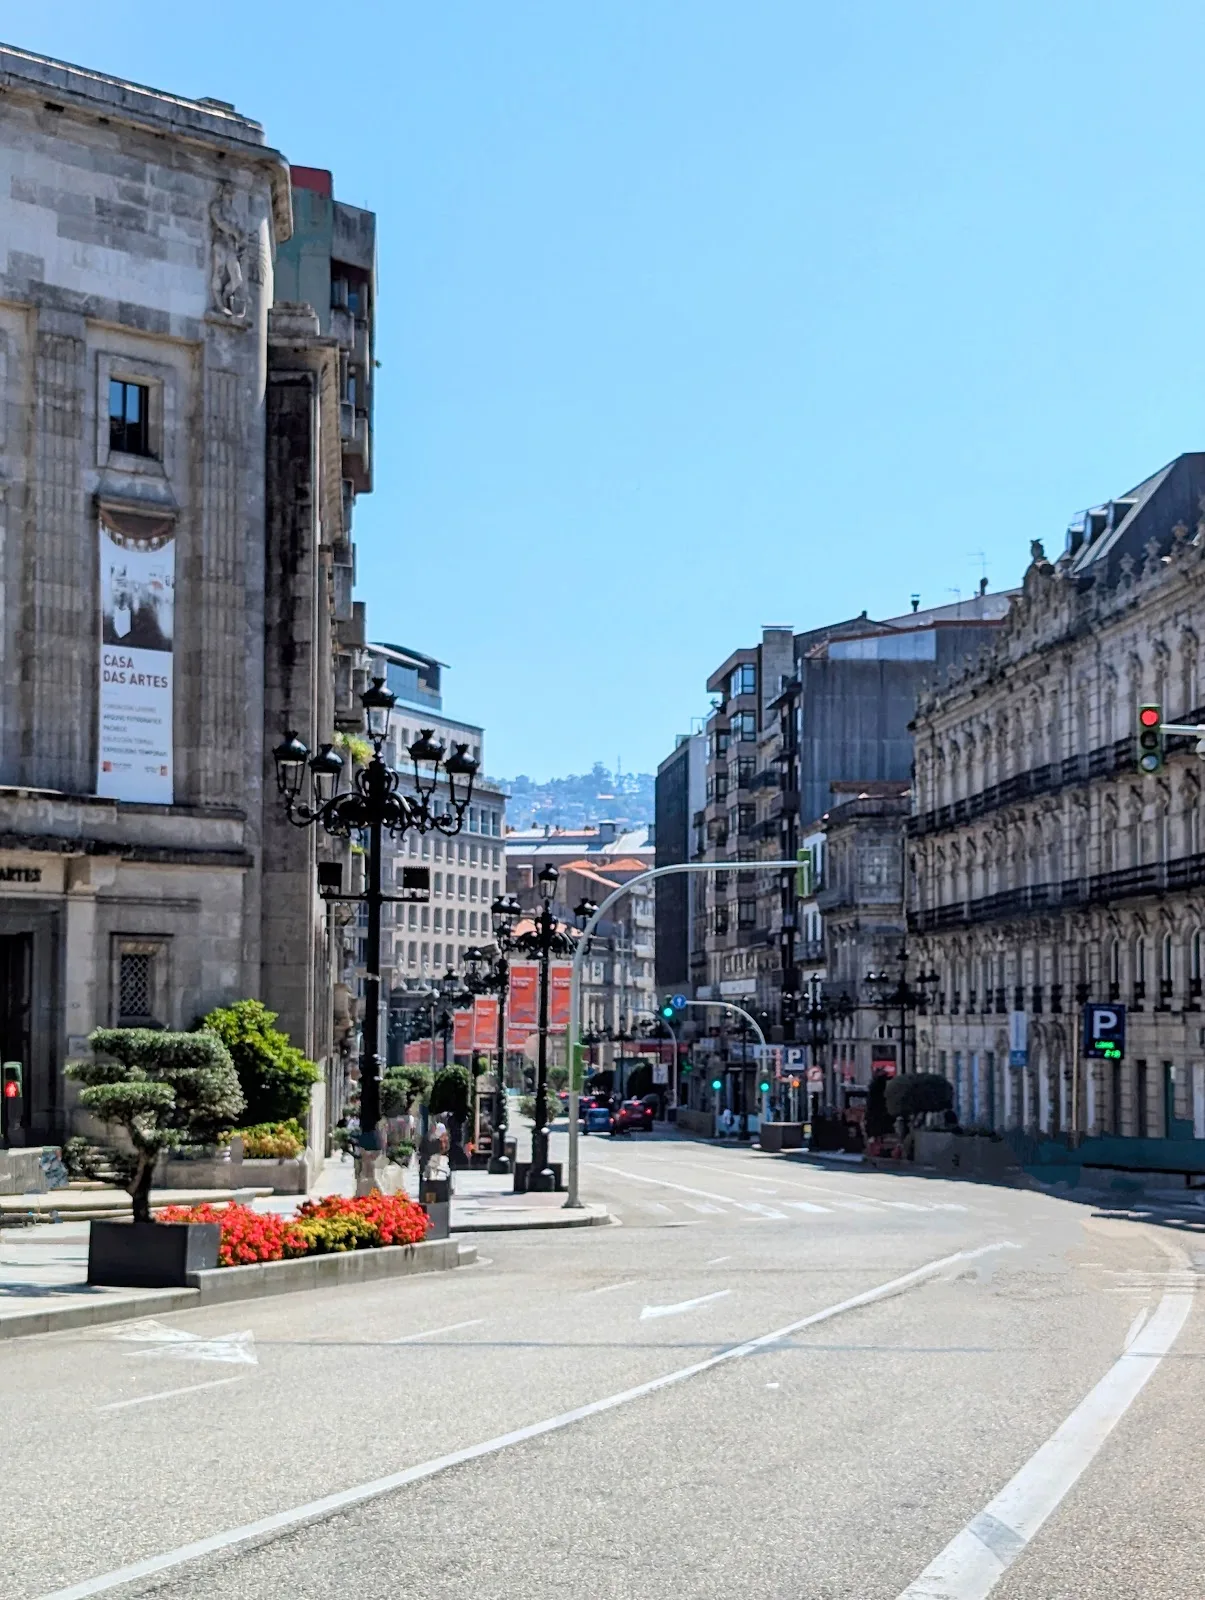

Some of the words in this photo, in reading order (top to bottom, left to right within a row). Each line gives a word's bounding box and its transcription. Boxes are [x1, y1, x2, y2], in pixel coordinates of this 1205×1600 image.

[103, 654, 134, 669] CASA
[103, 670, 126, 684] DAS
[129, 672, 168, 688] ARTES
[1093, 1010, 1118, 1039] P
[788, 1048, 801, 1064] P
